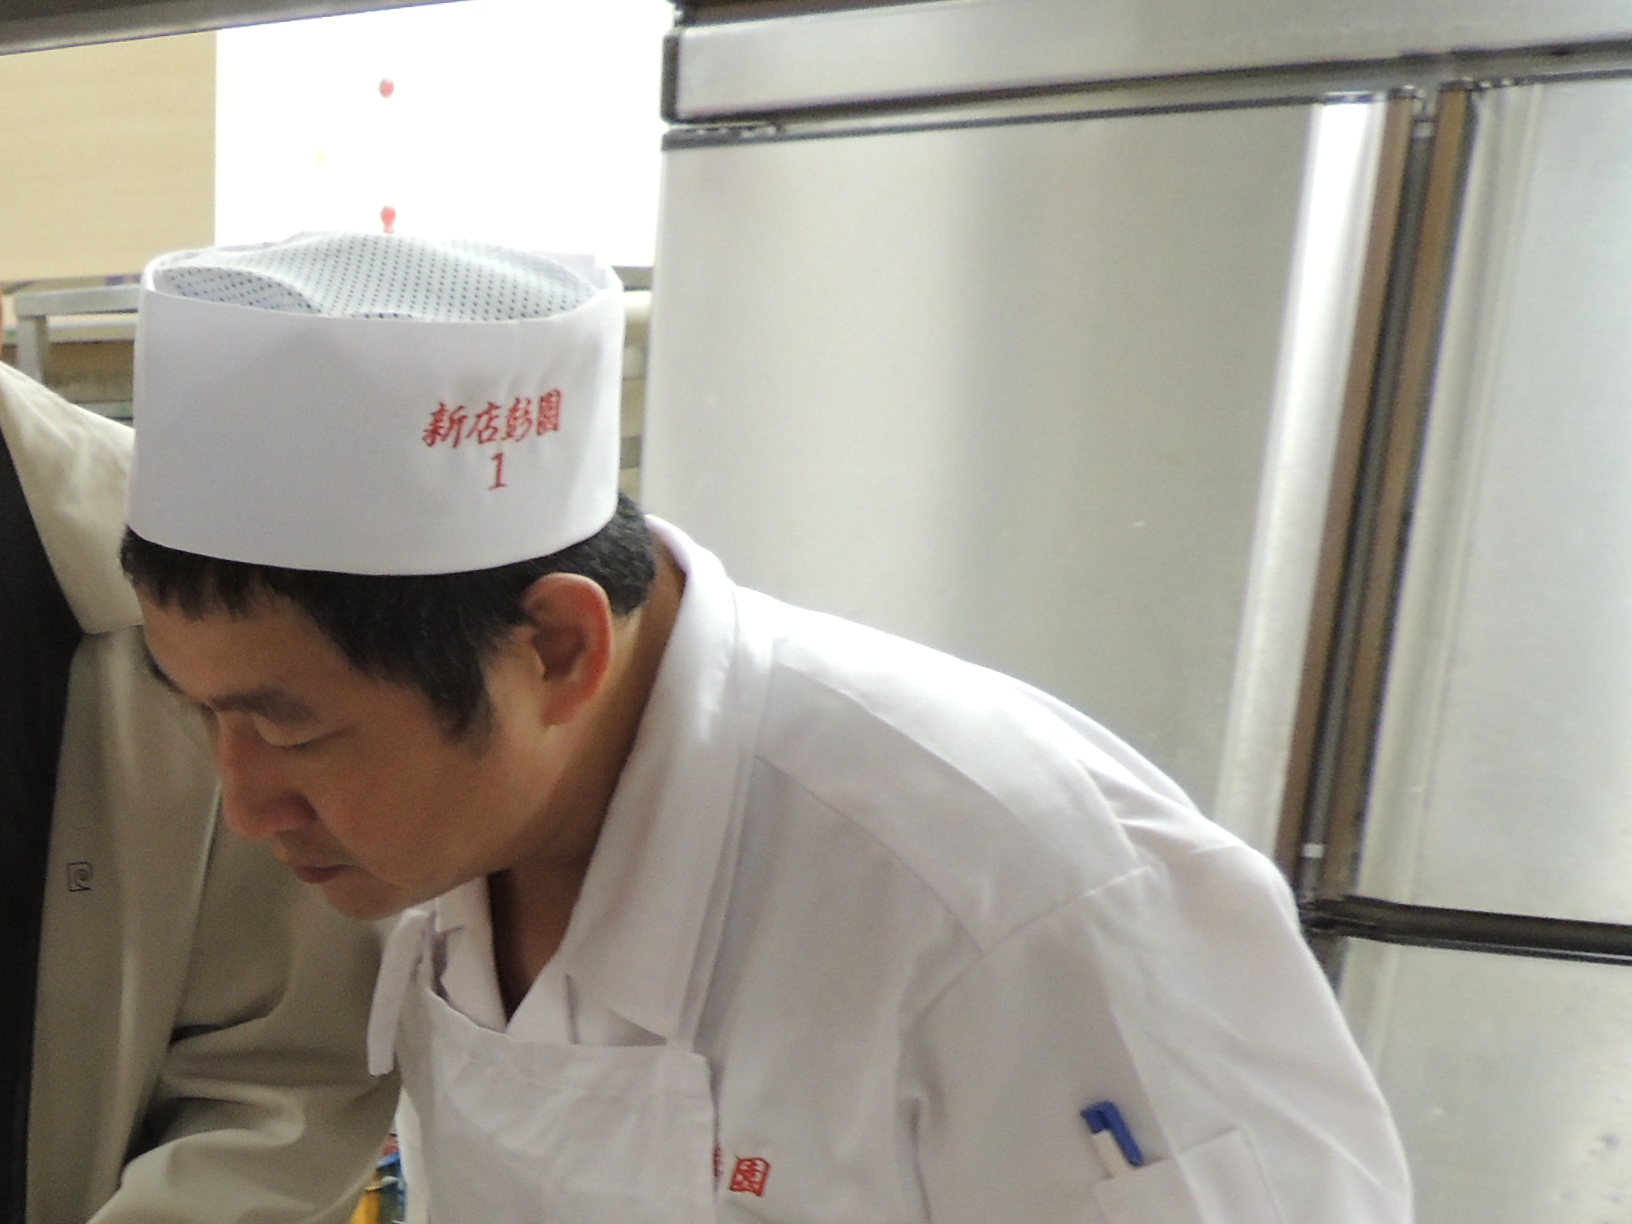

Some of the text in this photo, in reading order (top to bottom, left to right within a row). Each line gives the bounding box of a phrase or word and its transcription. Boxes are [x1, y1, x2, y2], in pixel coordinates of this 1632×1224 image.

[422, 388, 562, 449] 新店彭園
[488, 452, 507, 491] 1
